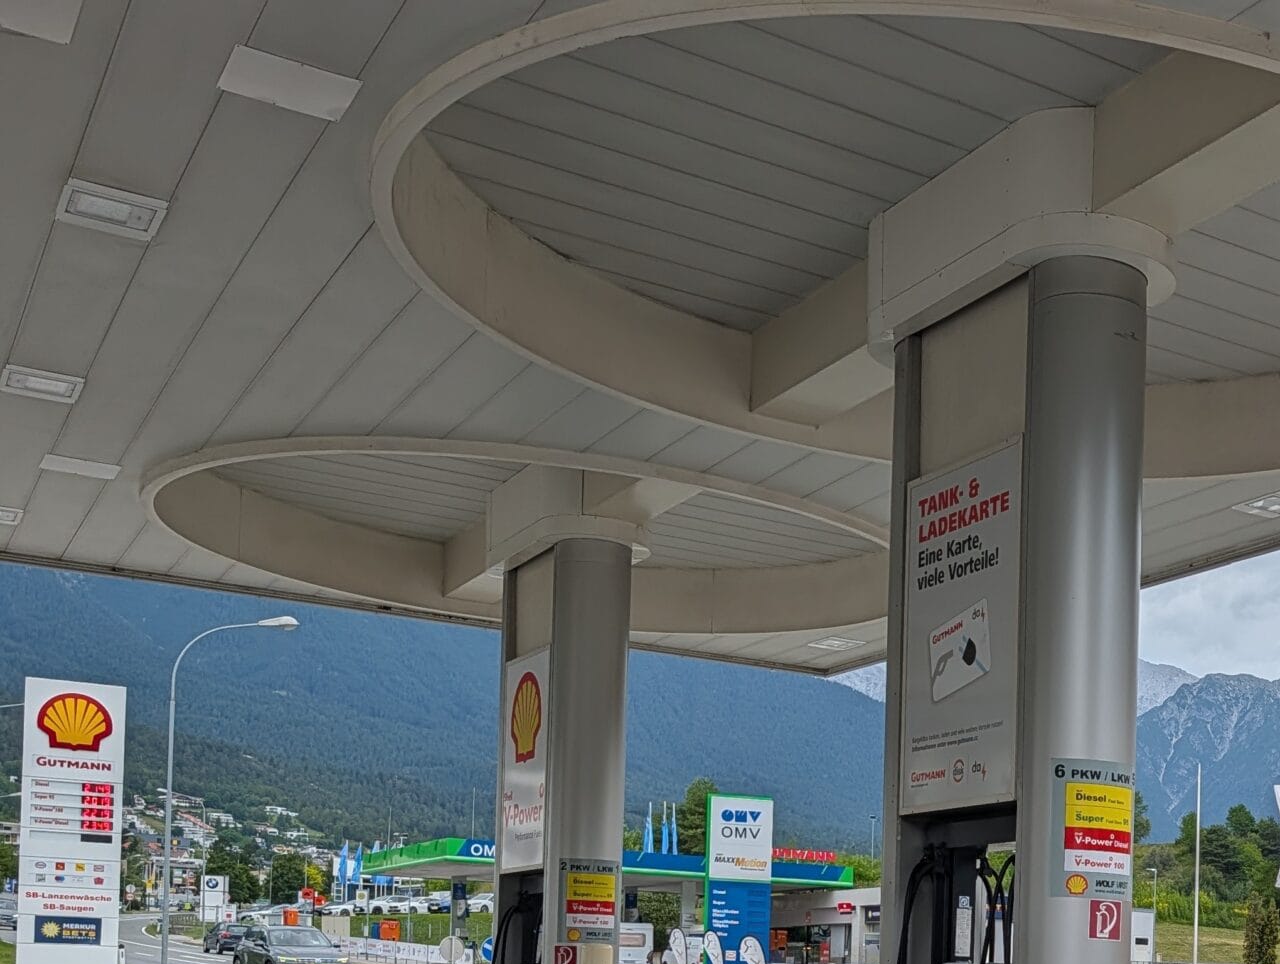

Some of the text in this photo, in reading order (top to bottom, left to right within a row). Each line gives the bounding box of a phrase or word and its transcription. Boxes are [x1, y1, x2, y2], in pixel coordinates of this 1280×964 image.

[918, 477, 980, 518] TANK- &
[918, 491, 1010, 543] LADEKARTE
[918, 534, 983, 568] Eine Karte,
[917, 547, 999, 590] viele Vorteile!
[932, 619, 964, 645] GUTMANN
[36, 756, 112, 771] GUTMANN
[911, 769, 946, 783] GUTMANN
[1054, 764, 1066, 779] 6
[1071, 769, 1102, 781] PKW
[1111, 772, 1130, 784] LKW
[1075, 792, 1107, 802] Diesel
[504, 804, 543, 828] V-Power
[1075, 813, 1105, 823] Super
[721, 826, 761, 839] OMV
[1075, 836, 1113, 847] V-Power
[471, 843, 496, 857] OM
[560, 861, 567, 871] 2
[1074, 858, 1125, 870] V-Power 100
[1095, 880, 1116, 888] WOLF
[25, 891, 112, 902] SB-Lanzenwäsche
[43, 903, 94, 912] SB-Saugen
